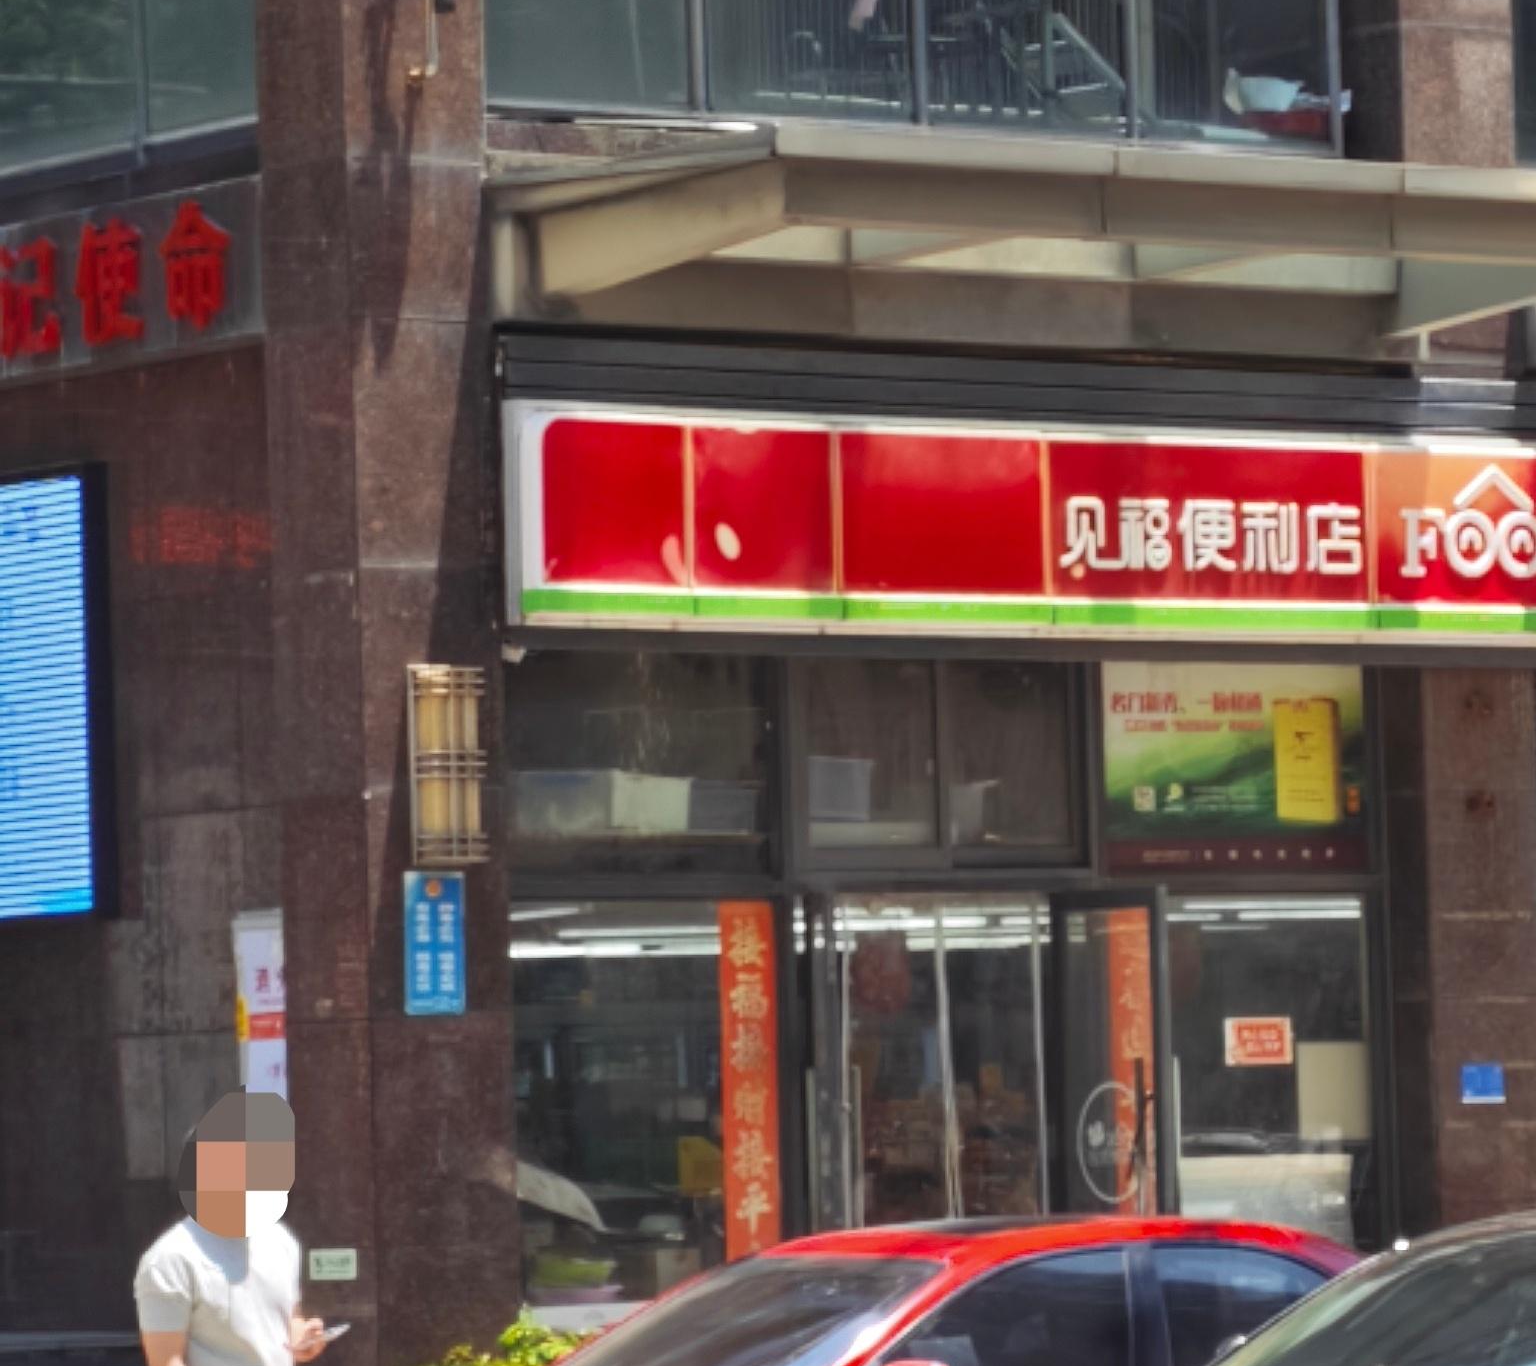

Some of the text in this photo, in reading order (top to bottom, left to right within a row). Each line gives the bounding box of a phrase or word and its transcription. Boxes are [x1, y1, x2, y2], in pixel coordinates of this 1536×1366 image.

[1060, 495, 1364, 575] 见福便利店
